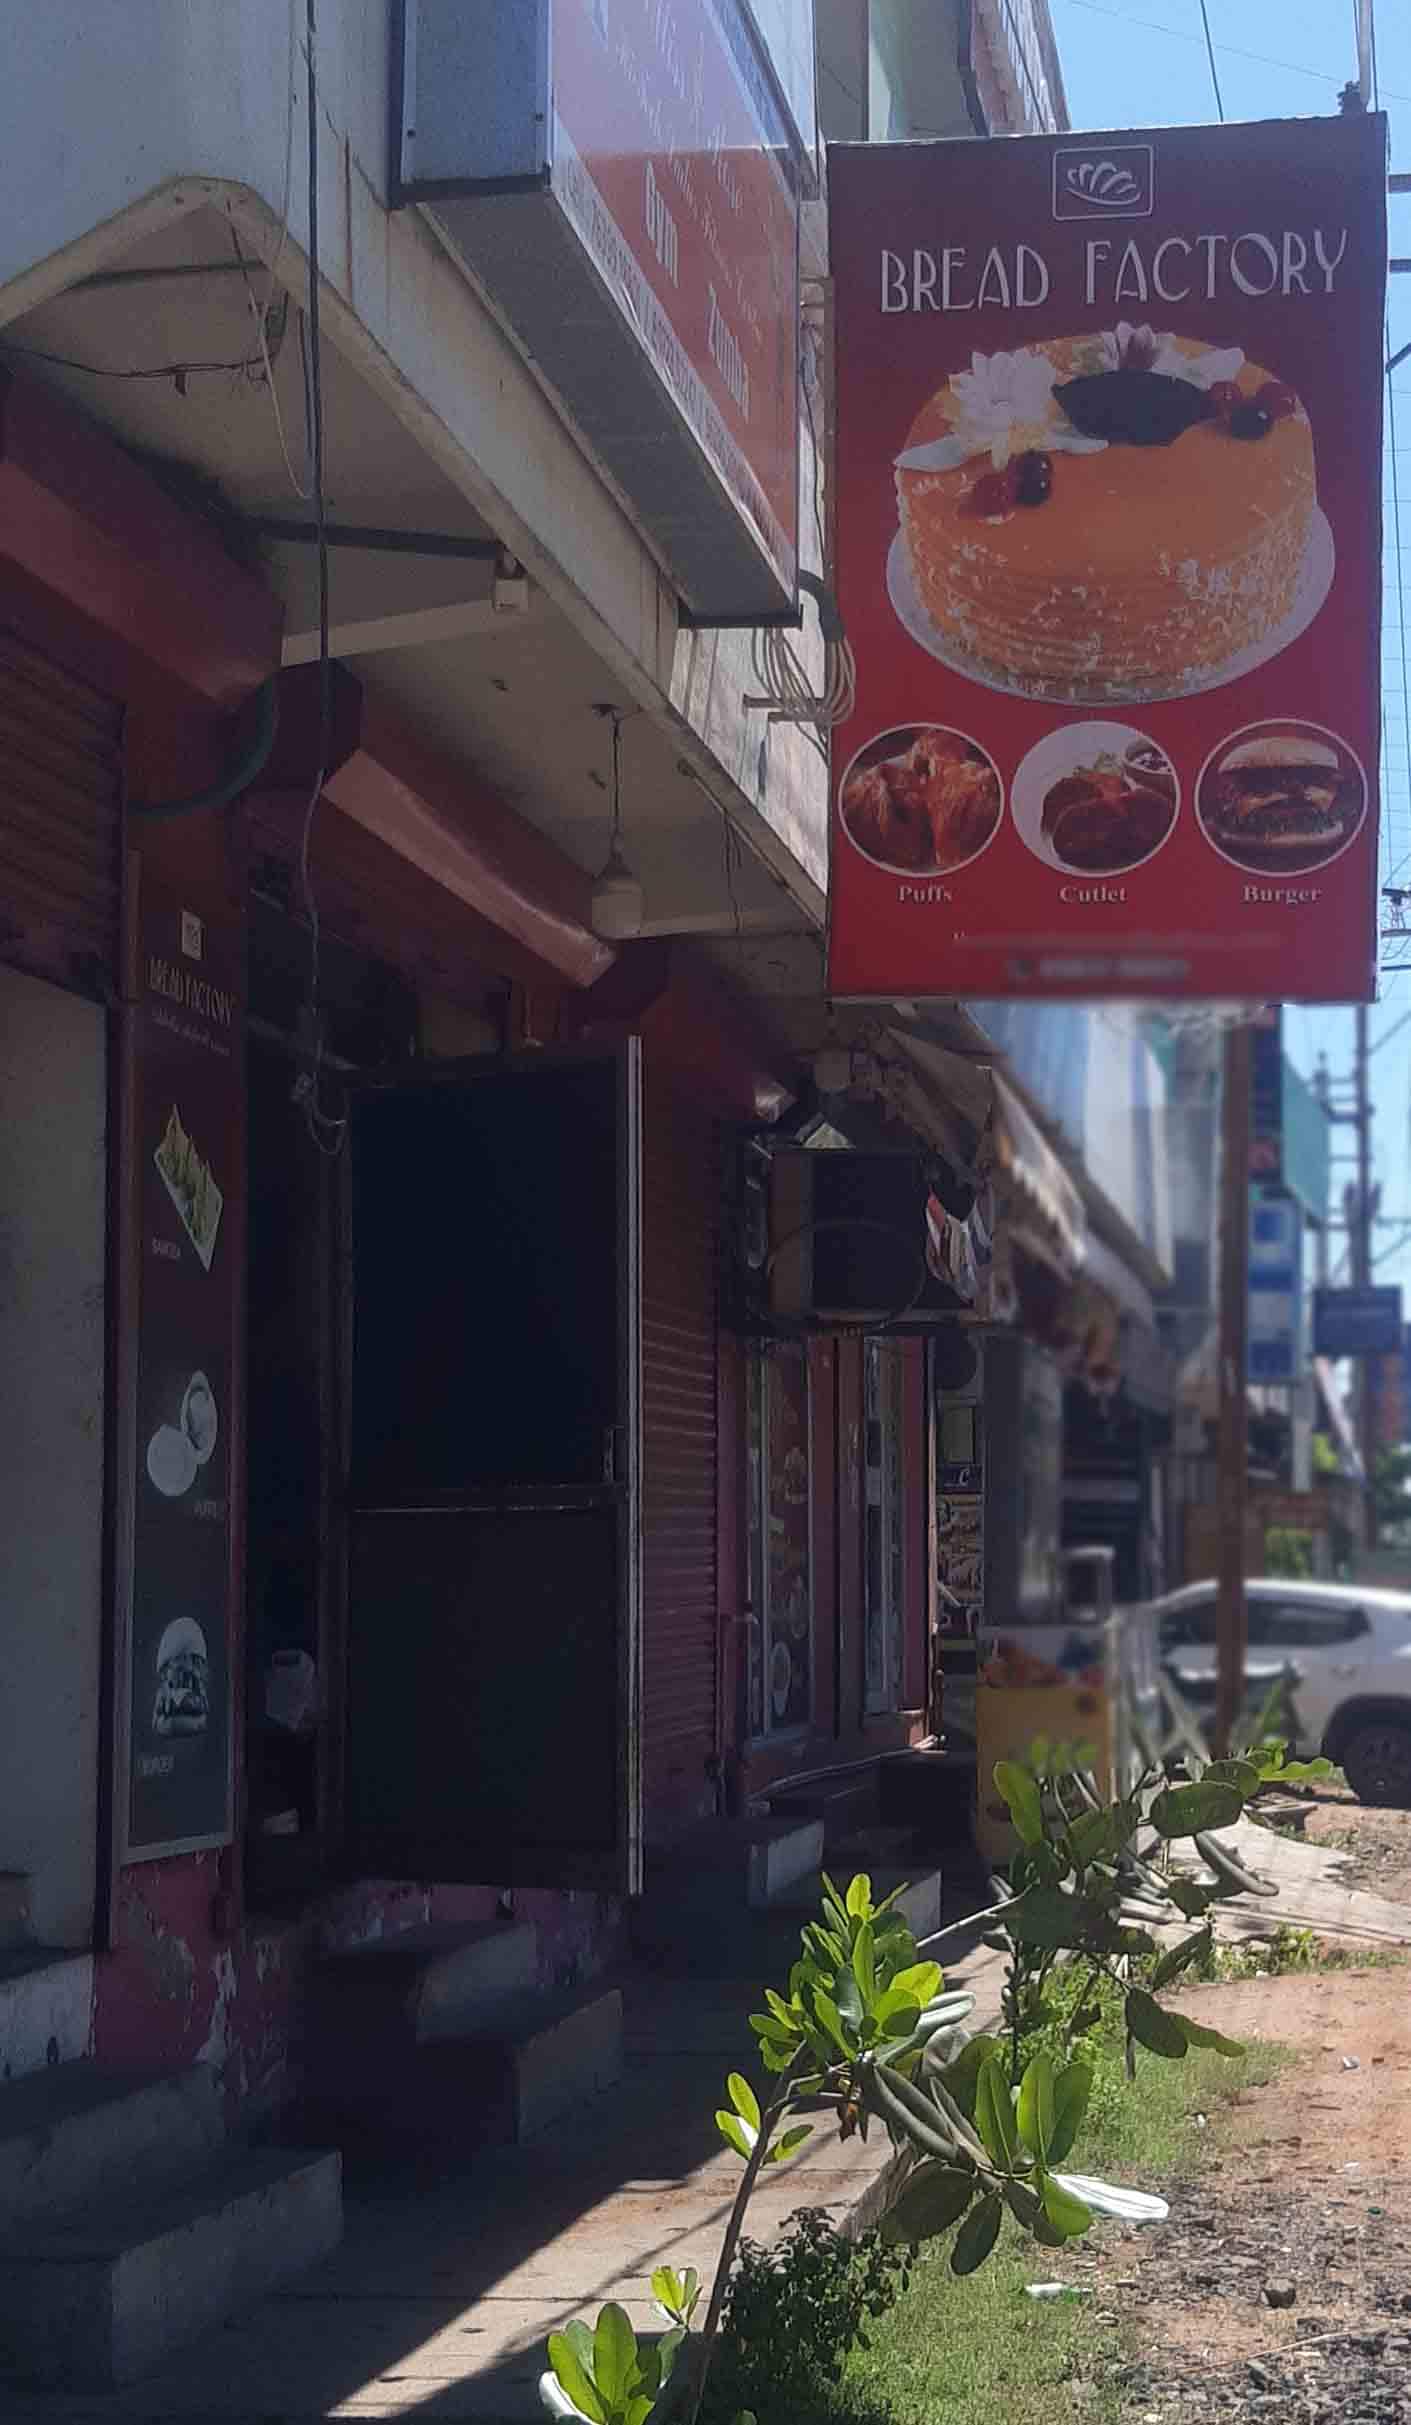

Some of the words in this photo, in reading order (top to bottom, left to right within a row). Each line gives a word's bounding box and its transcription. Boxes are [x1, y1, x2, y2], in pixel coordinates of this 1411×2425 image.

[881, 243, 1049, 313] BREAD
[1085, 229, 1347, 304] FACTORY
[899, 885, 952, 903] Puffs
[1058, 885, 1128, 903] Cutlet
[1242, 885, 1323, 905] Burger
